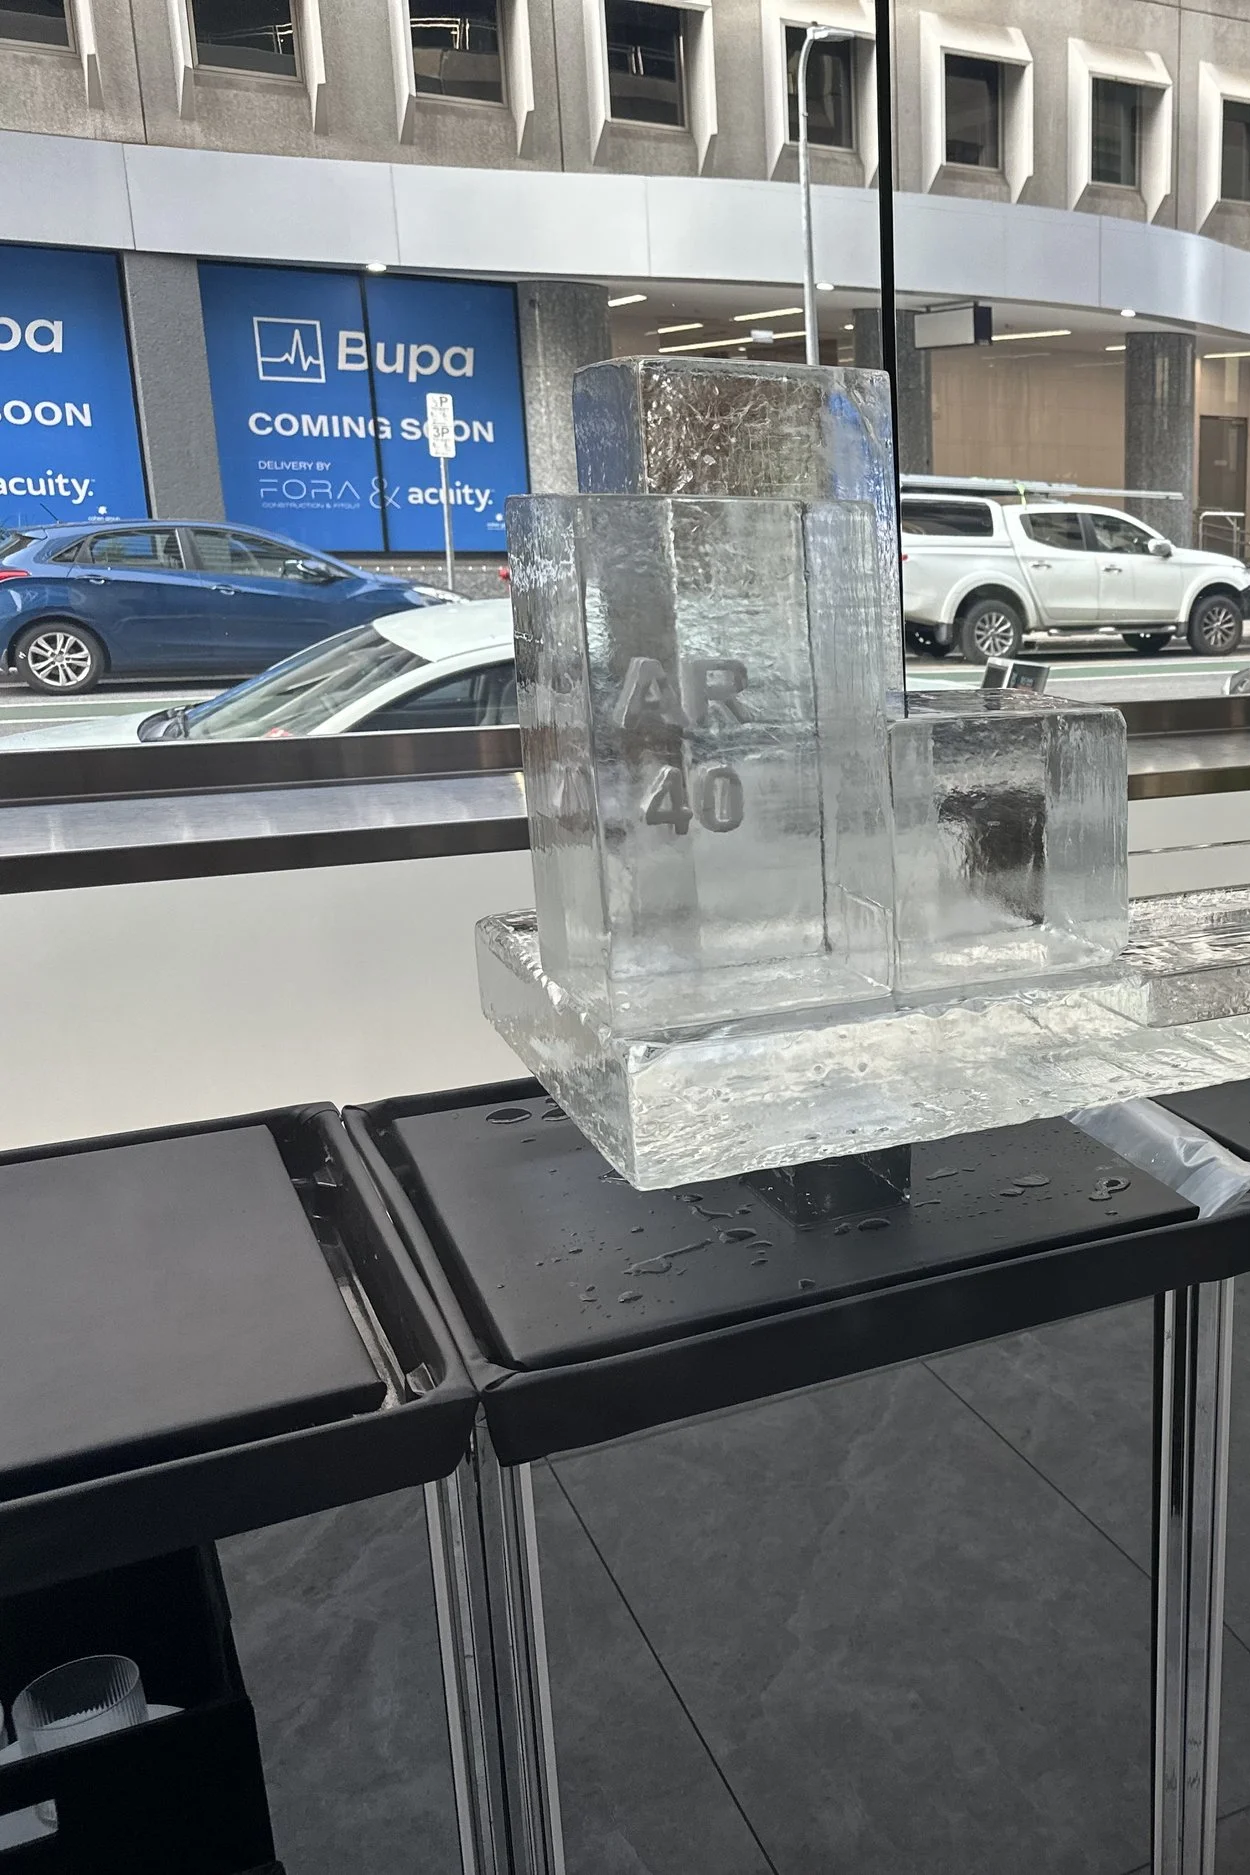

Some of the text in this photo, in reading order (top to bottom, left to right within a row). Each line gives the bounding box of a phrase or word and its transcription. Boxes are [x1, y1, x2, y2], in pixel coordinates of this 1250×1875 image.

[337, 330, 475, 382] Bupa
[0, 400, 92, 427] OON
[248, 412, 494, 443] COMING SON
[433, 426, 450, 438] 3P
[258, 460, 331, 471] DELIVERY BY
[259, 479, 360, 500] FORA
[369, 476, 400, 509] &
[613, 656, 756, 729] AR
[640, 764, 745, 836] 40
